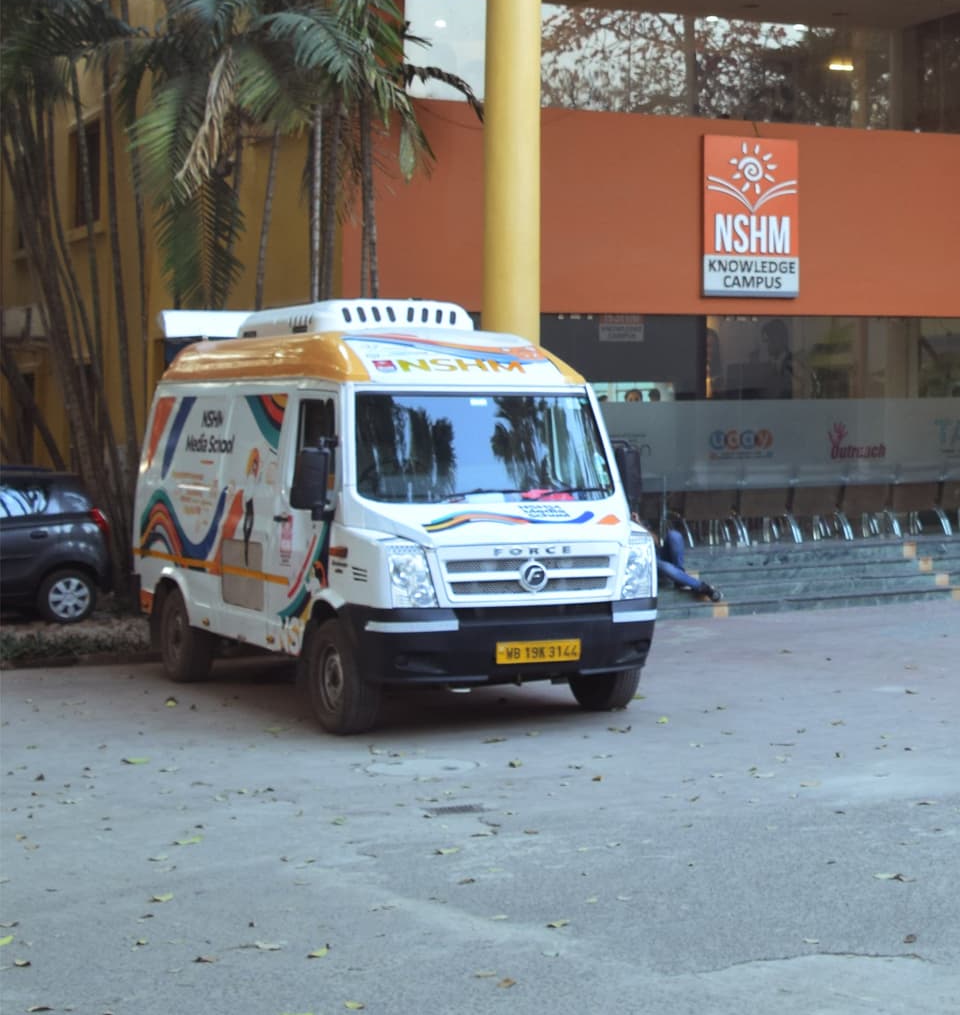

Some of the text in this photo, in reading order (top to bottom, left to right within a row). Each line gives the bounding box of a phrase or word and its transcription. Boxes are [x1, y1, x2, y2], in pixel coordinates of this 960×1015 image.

[715, 213, 790, 254] NSHM
[708, 259, 796, 274] KNOWLEDGE
[723, 275, 782, 289] CAMPUS
[397, 358, 526, 374] NSHM
[185, 433, 235, 454] Media School
[493, 546, 571, 556] FORCE
[506, 645, 577, 660] WB 19K 3144
